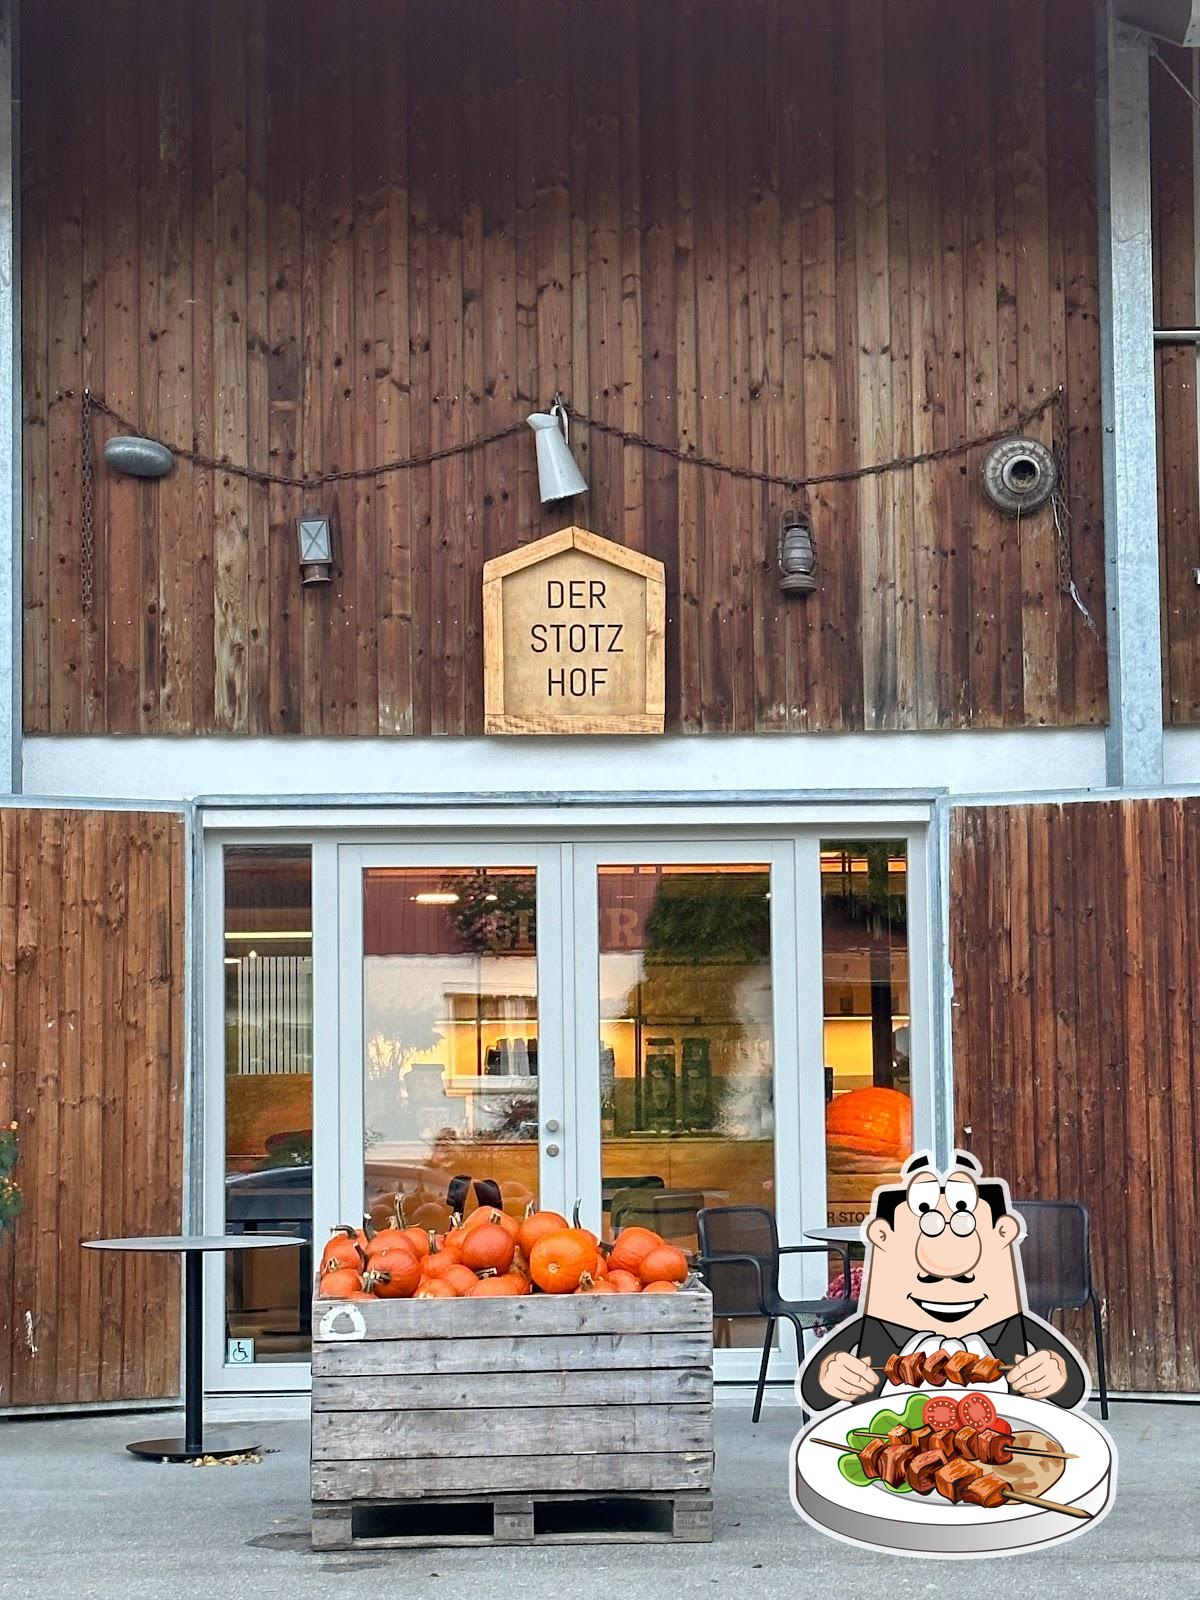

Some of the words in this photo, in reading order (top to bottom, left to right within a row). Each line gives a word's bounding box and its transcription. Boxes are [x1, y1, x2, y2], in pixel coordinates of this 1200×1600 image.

[547, 580, 607, 609] DER
[530, 624, 624, 653] STOTZ
[547, 667, 609, 697] HOF
